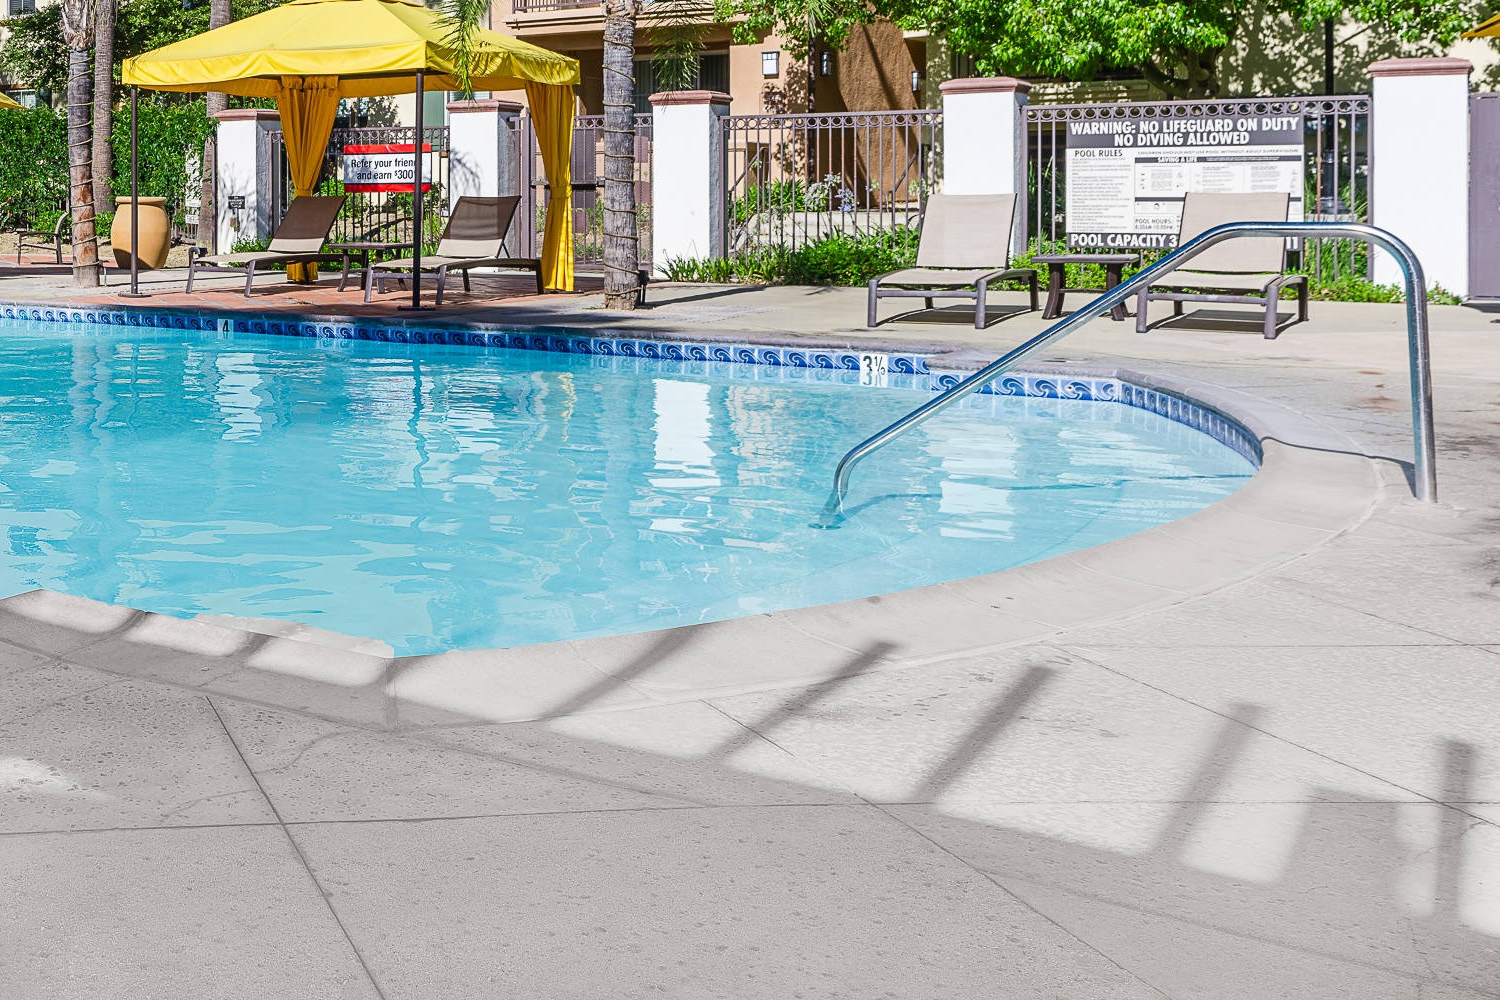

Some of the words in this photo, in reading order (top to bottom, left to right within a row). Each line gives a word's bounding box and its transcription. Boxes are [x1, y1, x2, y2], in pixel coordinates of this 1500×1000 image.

[1070, 121, 1136, 135] WARNING:
[1139, 120, 1159, 134] NO
[1162, 118, 1234, 133] LIFEGUARD
[1236, 117, 1258, 132] ON
[1261, 116, 1300, 131] DUTY
[1114, 133, 1134, 147] NO
[1137, 132, 1184, 146] DIVING
[1186, 131, 1250, 146] ALLOWED
[1074, 149, 1096, 158] POOL
[1098, 149, 1123, 157] RULES
[351, 158, 372, 168] Refer
[374, 160, 392, 169] your
[394, 158, 416, 167] frien
[357, 170, 372, 180] and
[373, 172, 392, 180] earn
[1070, 233, 1104, 247] POOL
[1107, 234, 1166, 248] CAPACITY
[222, 319, 230, 332] 4
